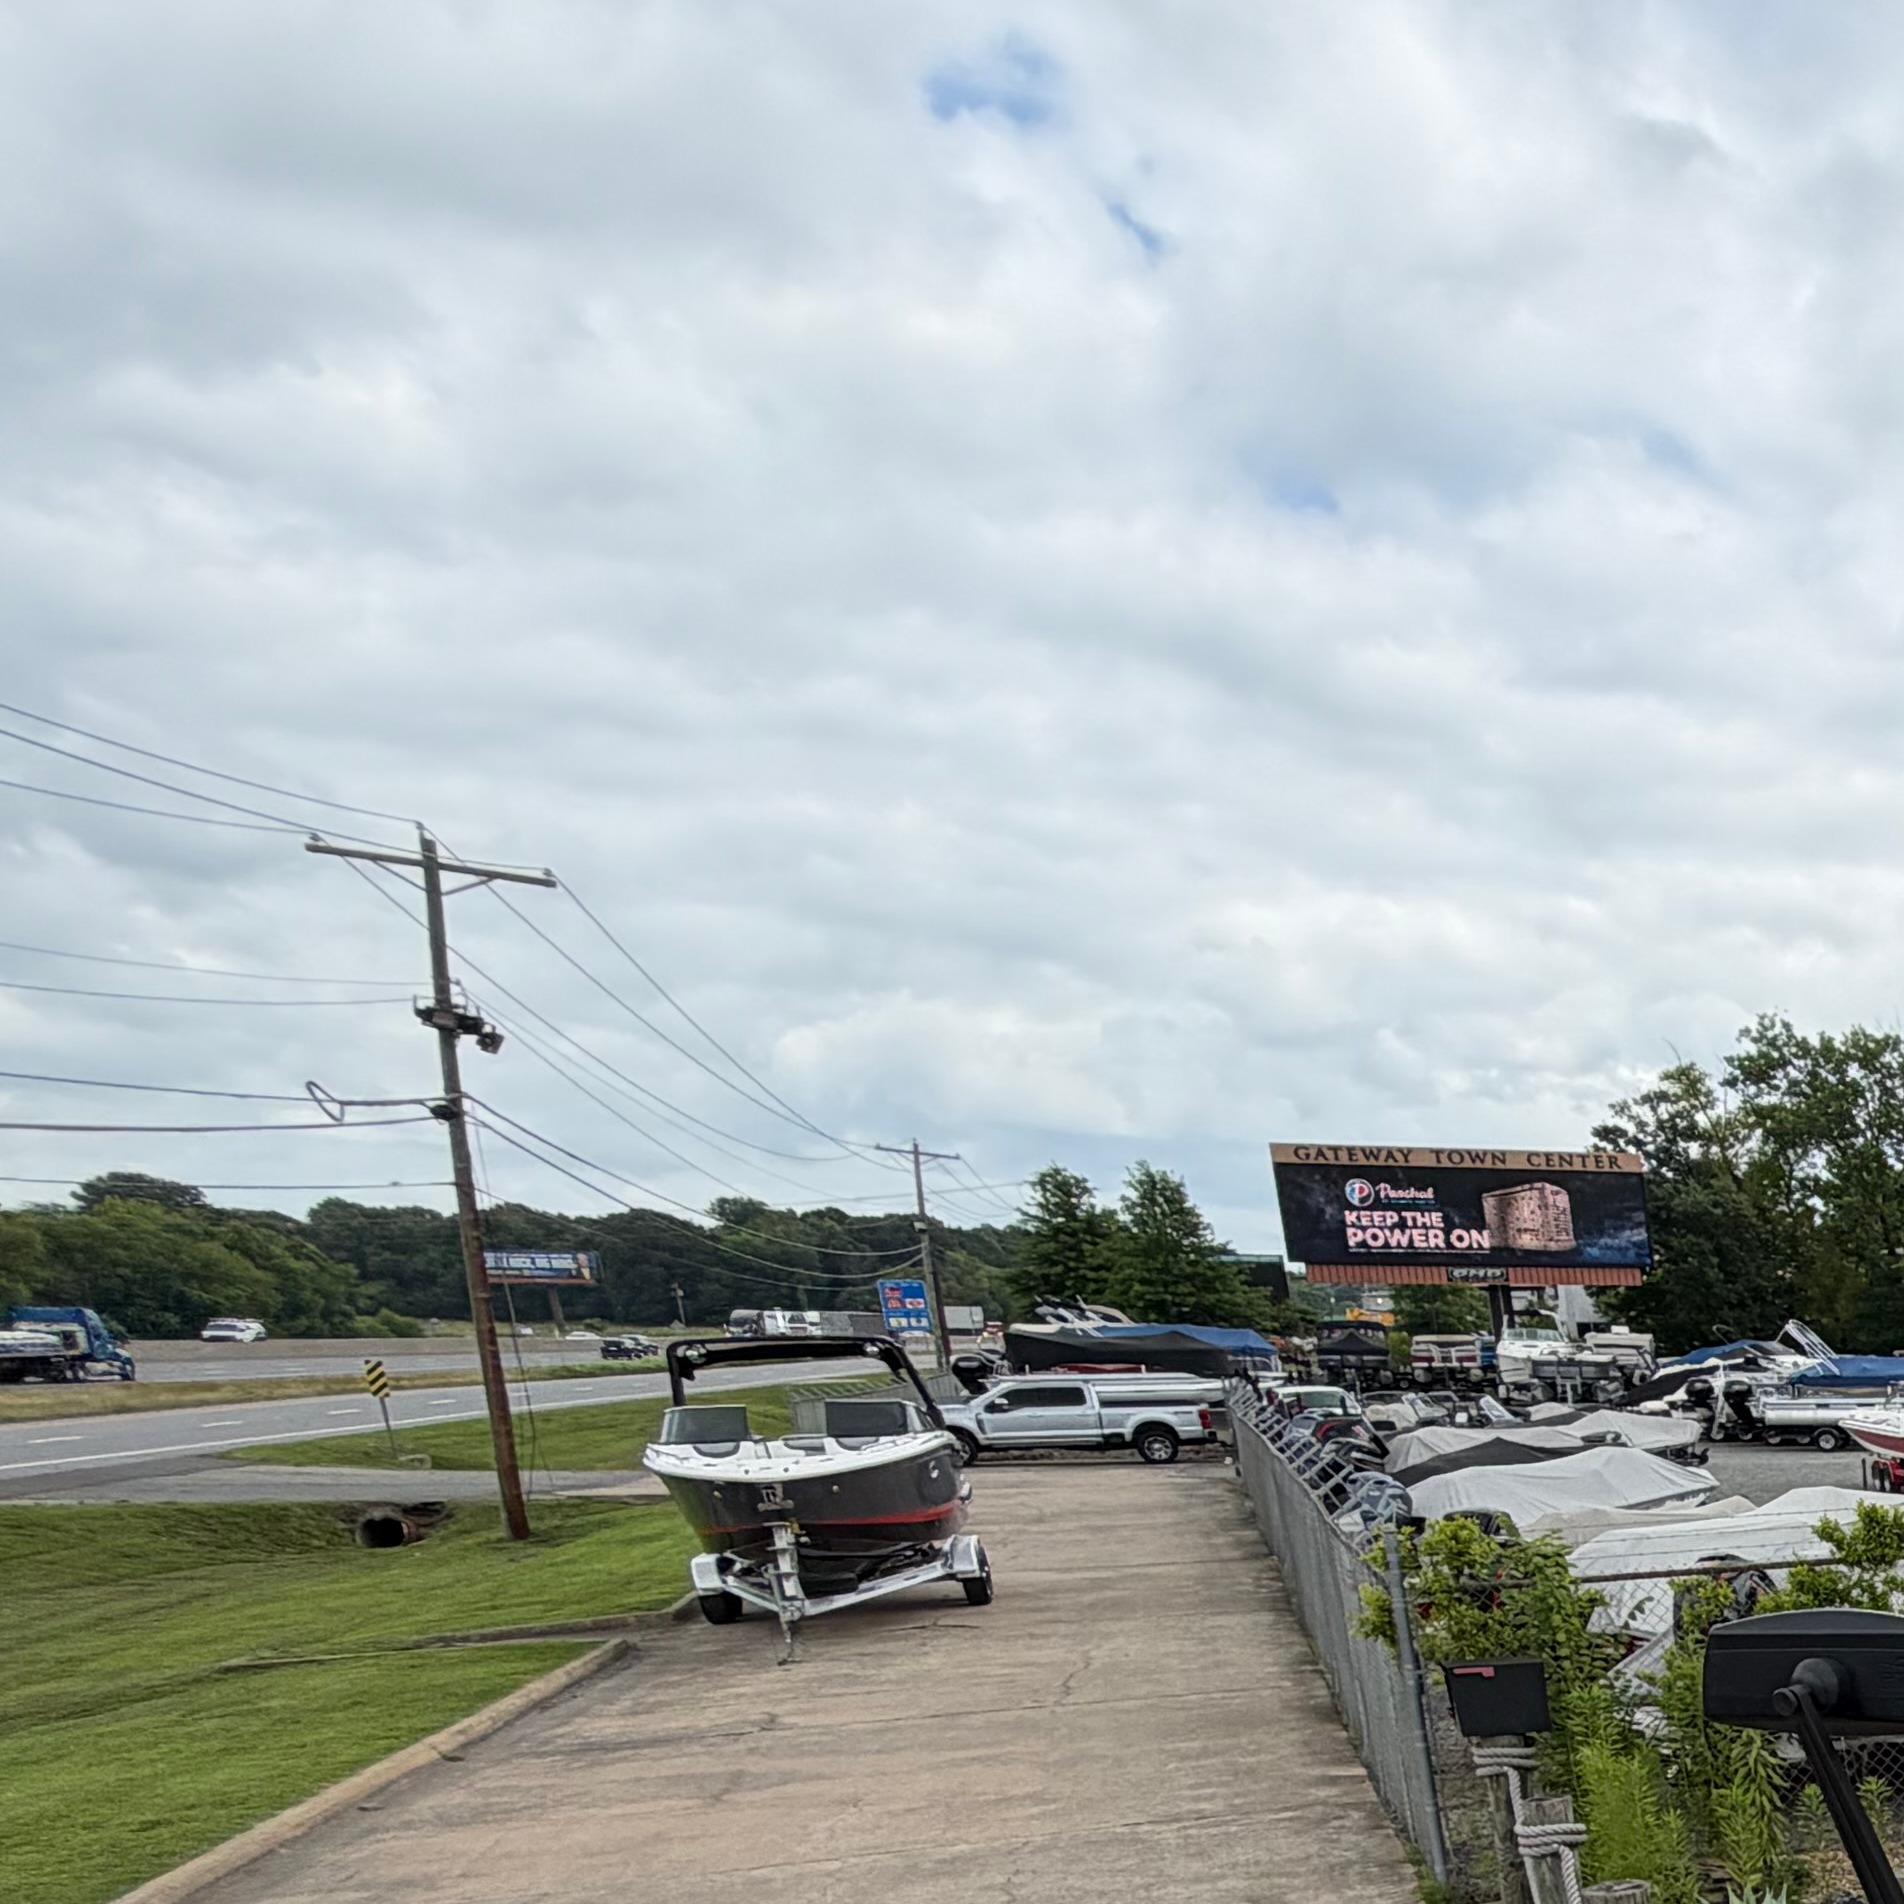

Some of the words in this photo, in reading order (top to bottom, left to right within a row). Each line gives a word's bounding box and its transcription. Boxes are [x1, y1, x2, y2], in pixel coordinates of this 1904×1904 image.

[1293, 1146, 1413, 1164] GATEWAY
[1430, 1150, 1507, 1166] TOWN
[1526, 1152, 1622, 1170] CENTER
[1344, 1210, 1399, 1226] KEEP
[1401, 1211, 1445, 1228] THE
[1346, 1227, 1446, 1248] POWER
[1450, 1228, 1491, 1249] ON
